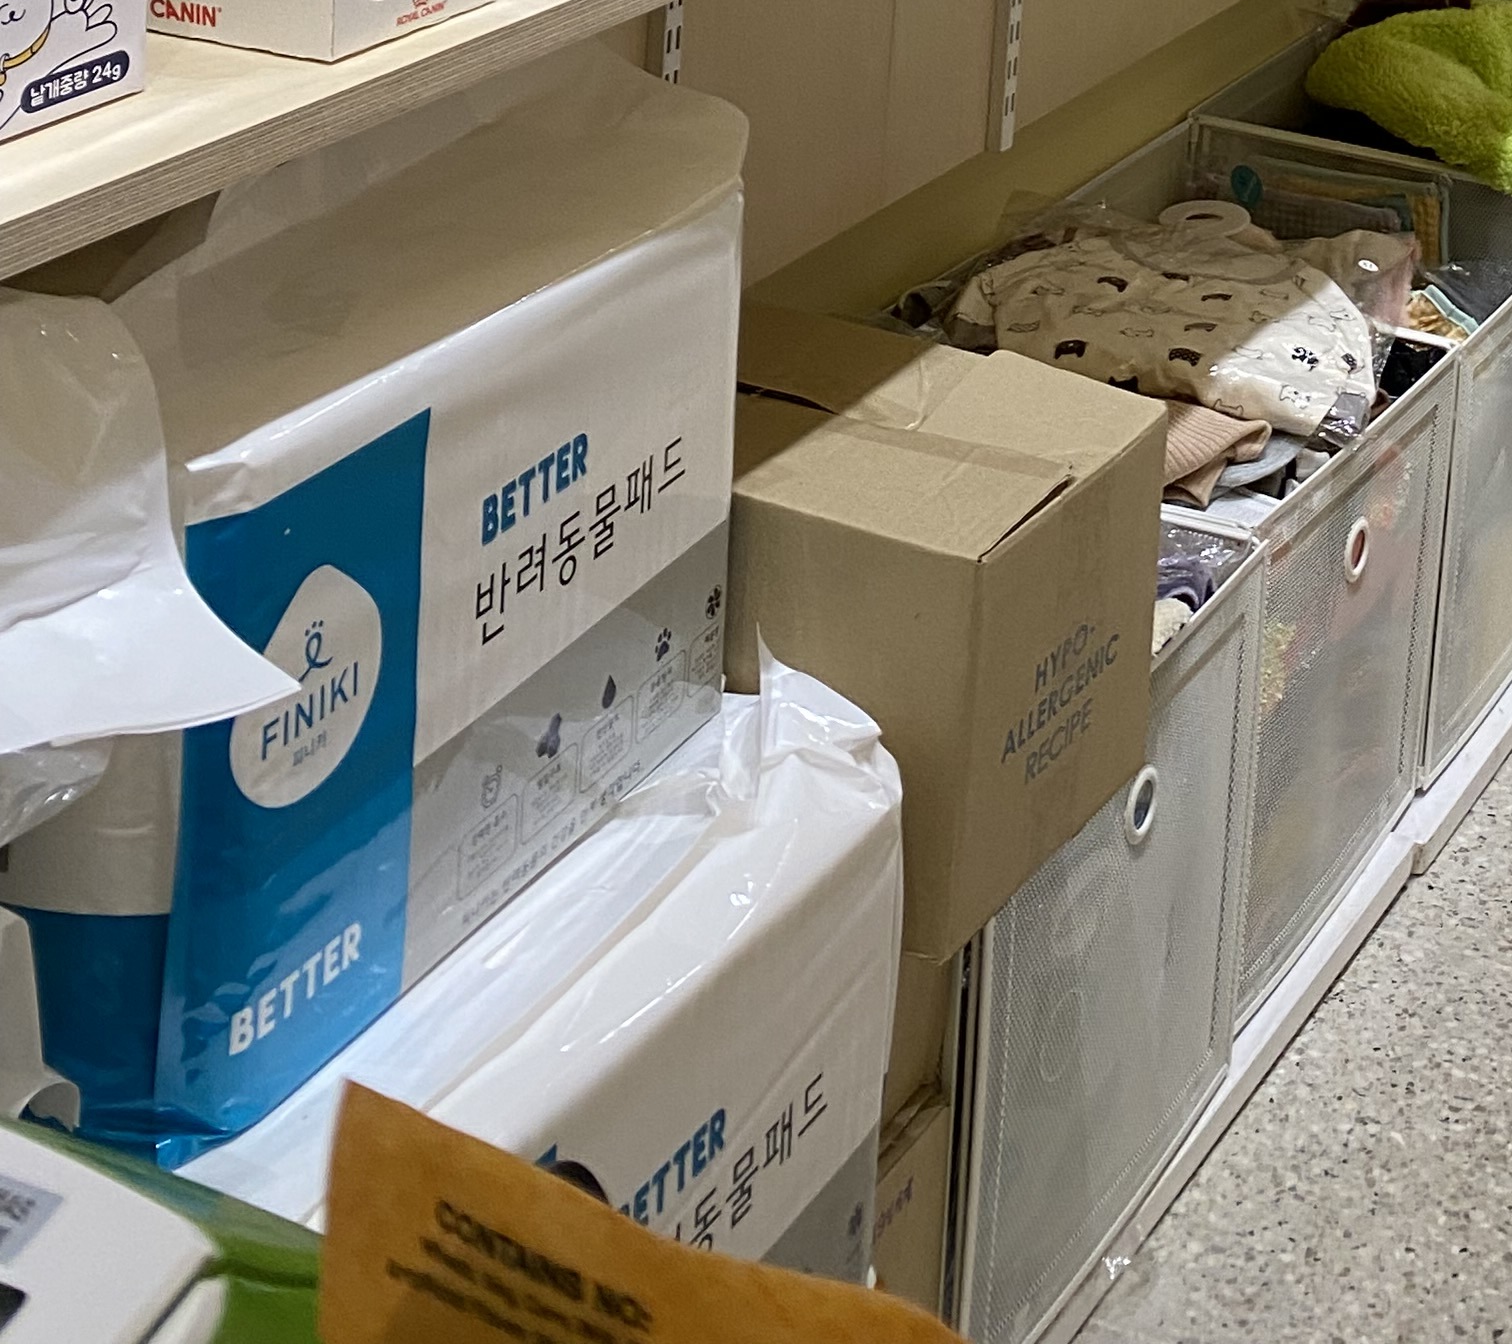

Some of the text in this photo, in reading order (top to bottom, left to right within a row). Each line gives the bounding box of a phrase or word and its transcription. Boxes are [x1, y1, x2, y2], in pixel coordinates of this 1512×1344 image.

[396, 1, 446, 27] ROYAL CANIN
[91, 59, 122, 84] 24g
[480, 431, 591, 547] BETTER
[474, 436, 687, 648] 반려동물패드
[1001, 632, 1122, 766] ALLERGENIC
[1033, 621, 1098, 692] HYPO-
[260, 660, 362, 764] FINIKI
[292, 732, 328, 770] 피니키
[1023, 697, 1095, 786] RECIPE
[228, 922, 362, 1058] BETTER
[674, 1071, 829, 1250] 동물패드
